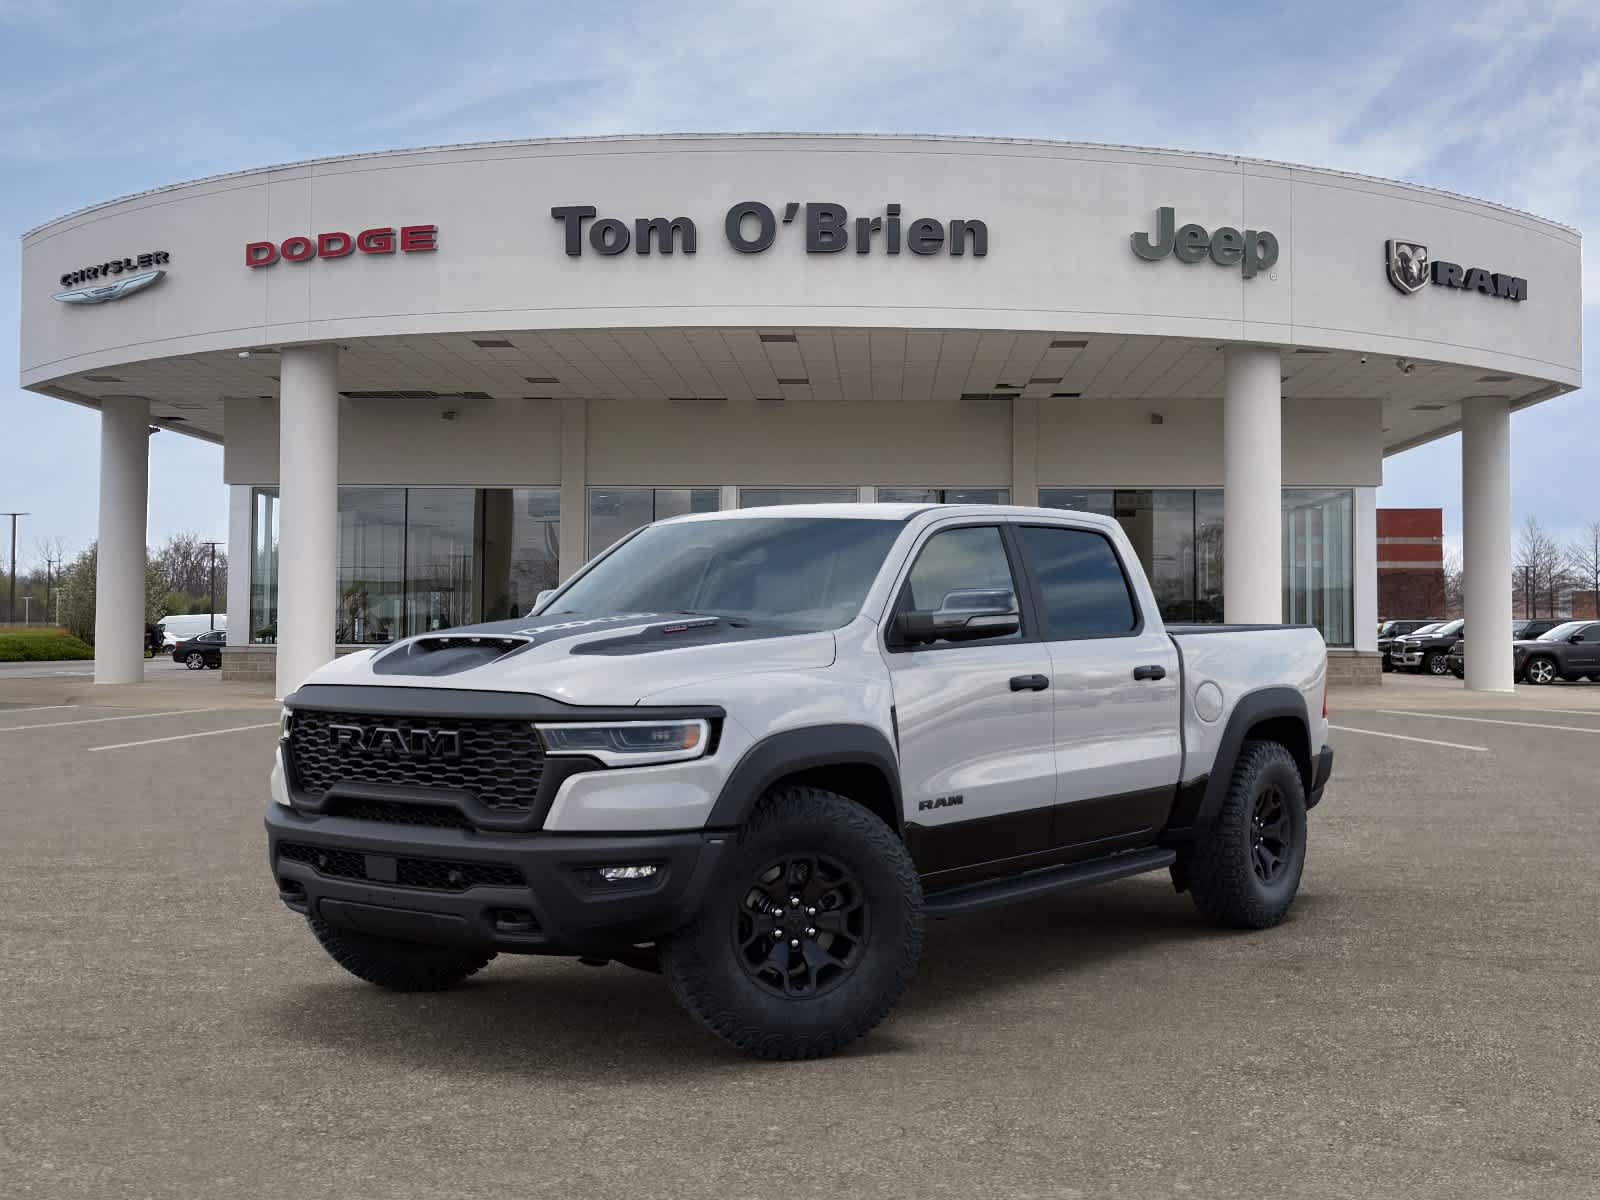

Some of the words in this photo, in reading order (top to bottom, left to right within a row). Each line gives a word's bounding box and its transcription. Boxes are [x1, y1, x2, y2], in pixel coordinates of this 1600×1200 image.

[245, 224, 438, 269] DODGE
[551, 205, 697, 256] Tom
[725, 201, 989, 256] O'Brien
[1130, 206, 1279, 279] Jeep
[60, 250, 169, 286] CHRYSLER
[1431, 260, 1528, 302] RAM
[328, 724, 460, 757] RAM
[919, 795, 964, 811] RAM
